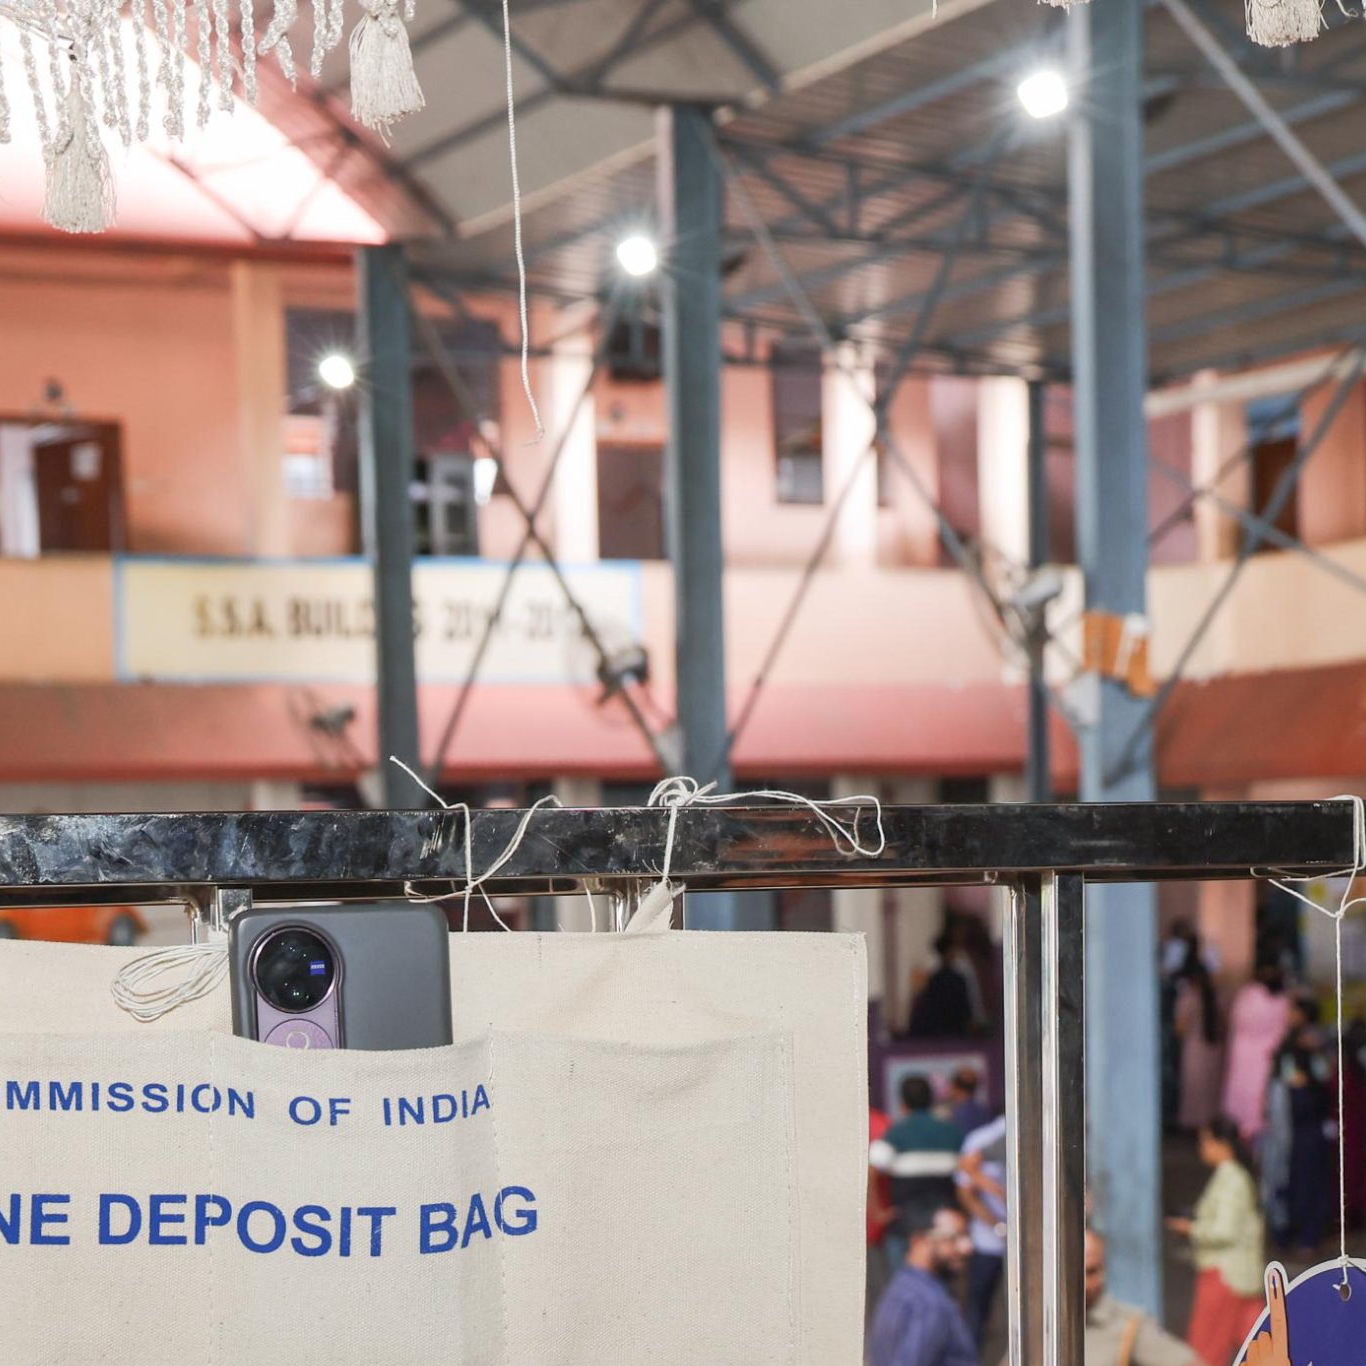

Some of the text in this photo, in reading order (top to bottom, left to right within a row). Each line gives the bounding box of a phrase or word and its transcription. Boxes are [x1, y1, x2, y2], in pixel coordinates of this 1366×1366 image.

[289, 1096, 351, 1126] OF
[383, 1085, 490, 1127] INDIA
[98, 1193, 396, 1257] DEPOSIT
[419, 1186, 538, 1255] BAG
